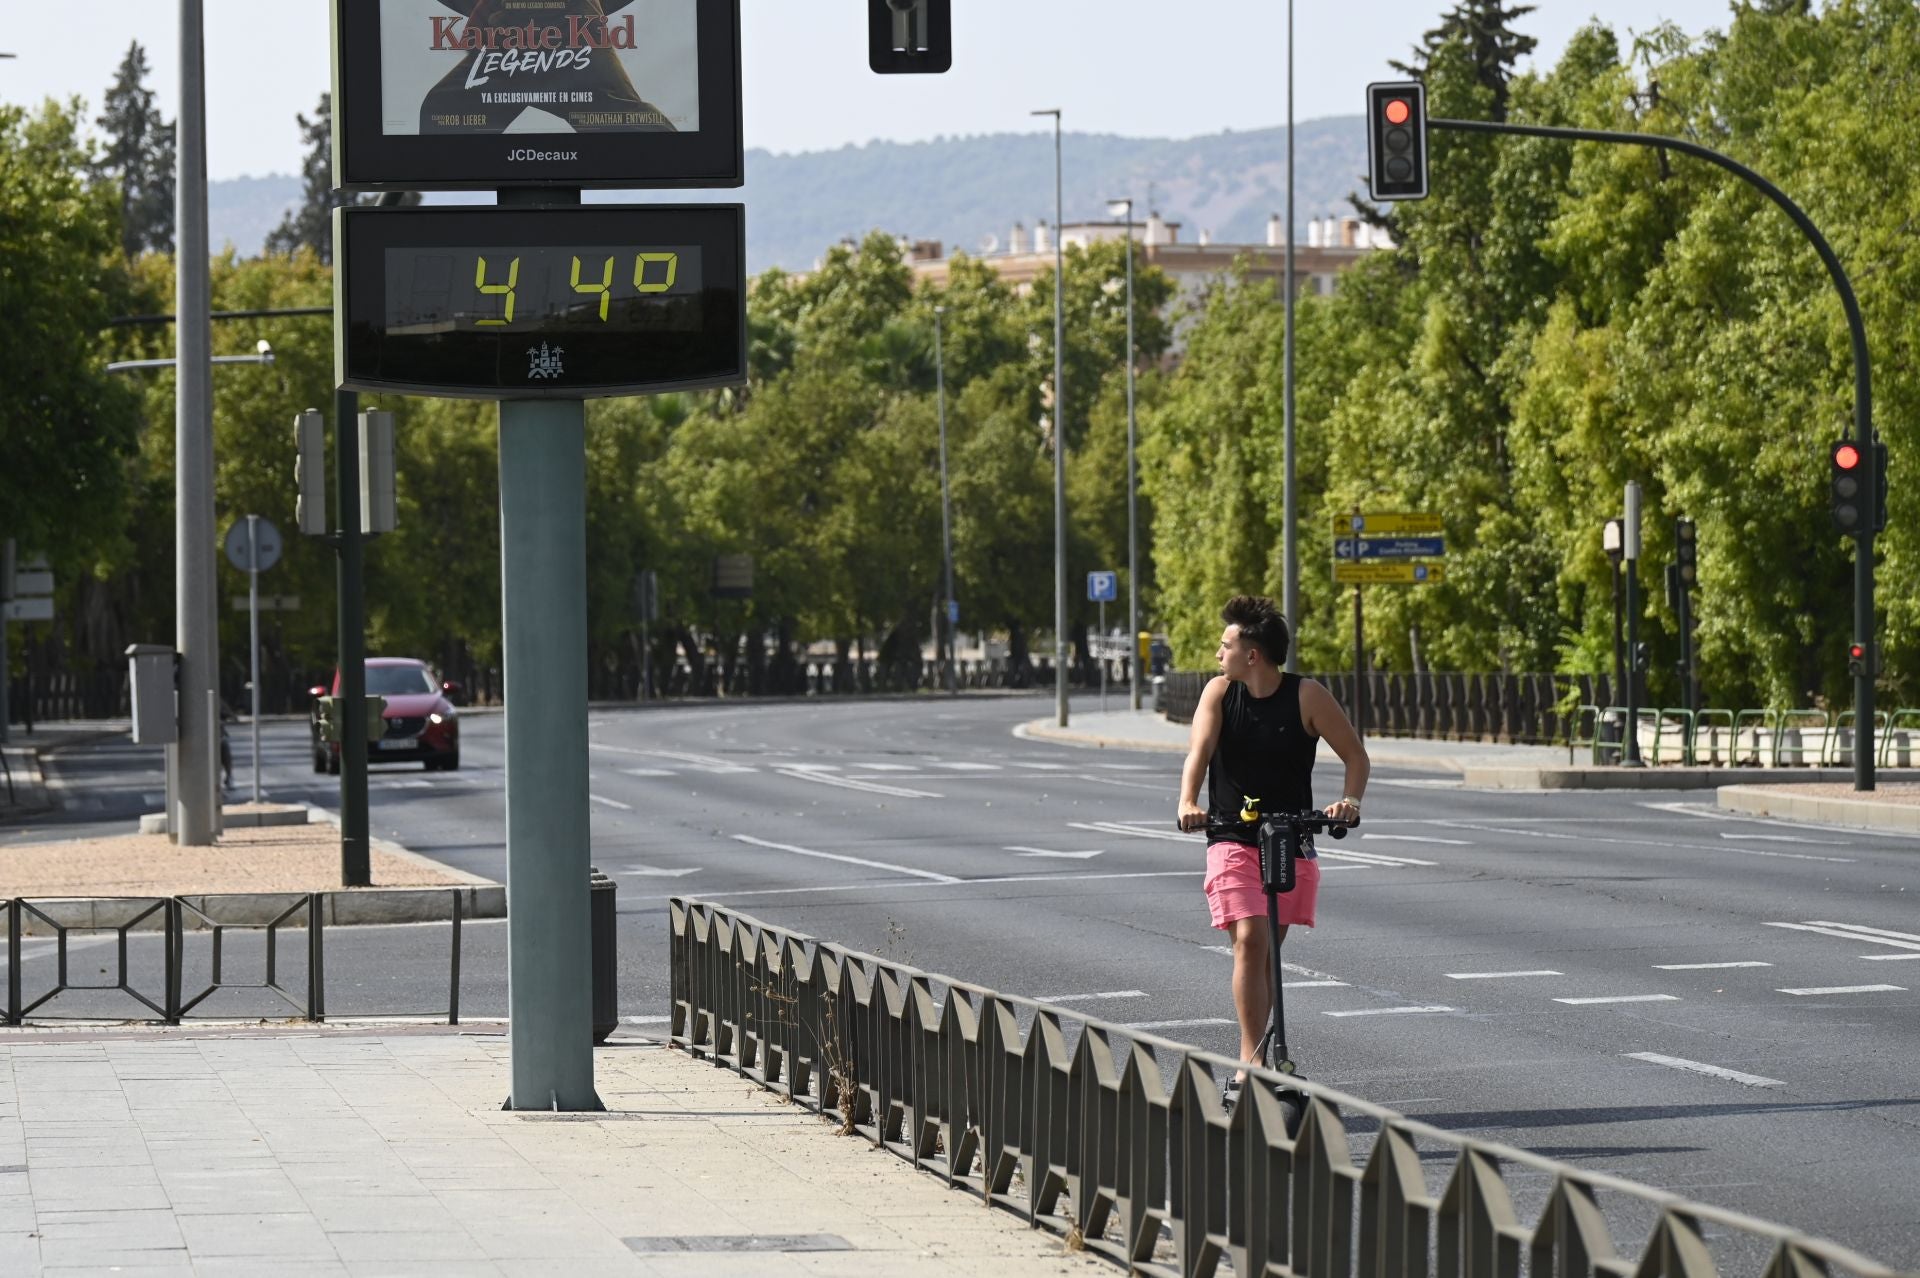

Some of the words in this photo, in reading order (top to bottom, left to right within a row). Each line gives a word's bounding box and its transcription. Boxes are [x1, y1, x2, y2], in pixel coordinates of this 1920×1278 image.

[429, 16, 563, 51] Karate
[564, 14, 638, 50] Kid
[464, 45, 593, 90] LEGENDS
[481, 92, 493, 104] YA
[494, 91, 557, 103] EXCLUSIVAMENTE
[559, 91, 569, 103] EN
[571, 91, 593, 103] CINES
[445, 114, 460, 126] ROB
[463, 114, 487, 126] LIEBER
[586, 112, 622, 125] JONATHAN
[507, 149, 578, 161] JCDecaux
[1093, 575, 1110, 597] P
